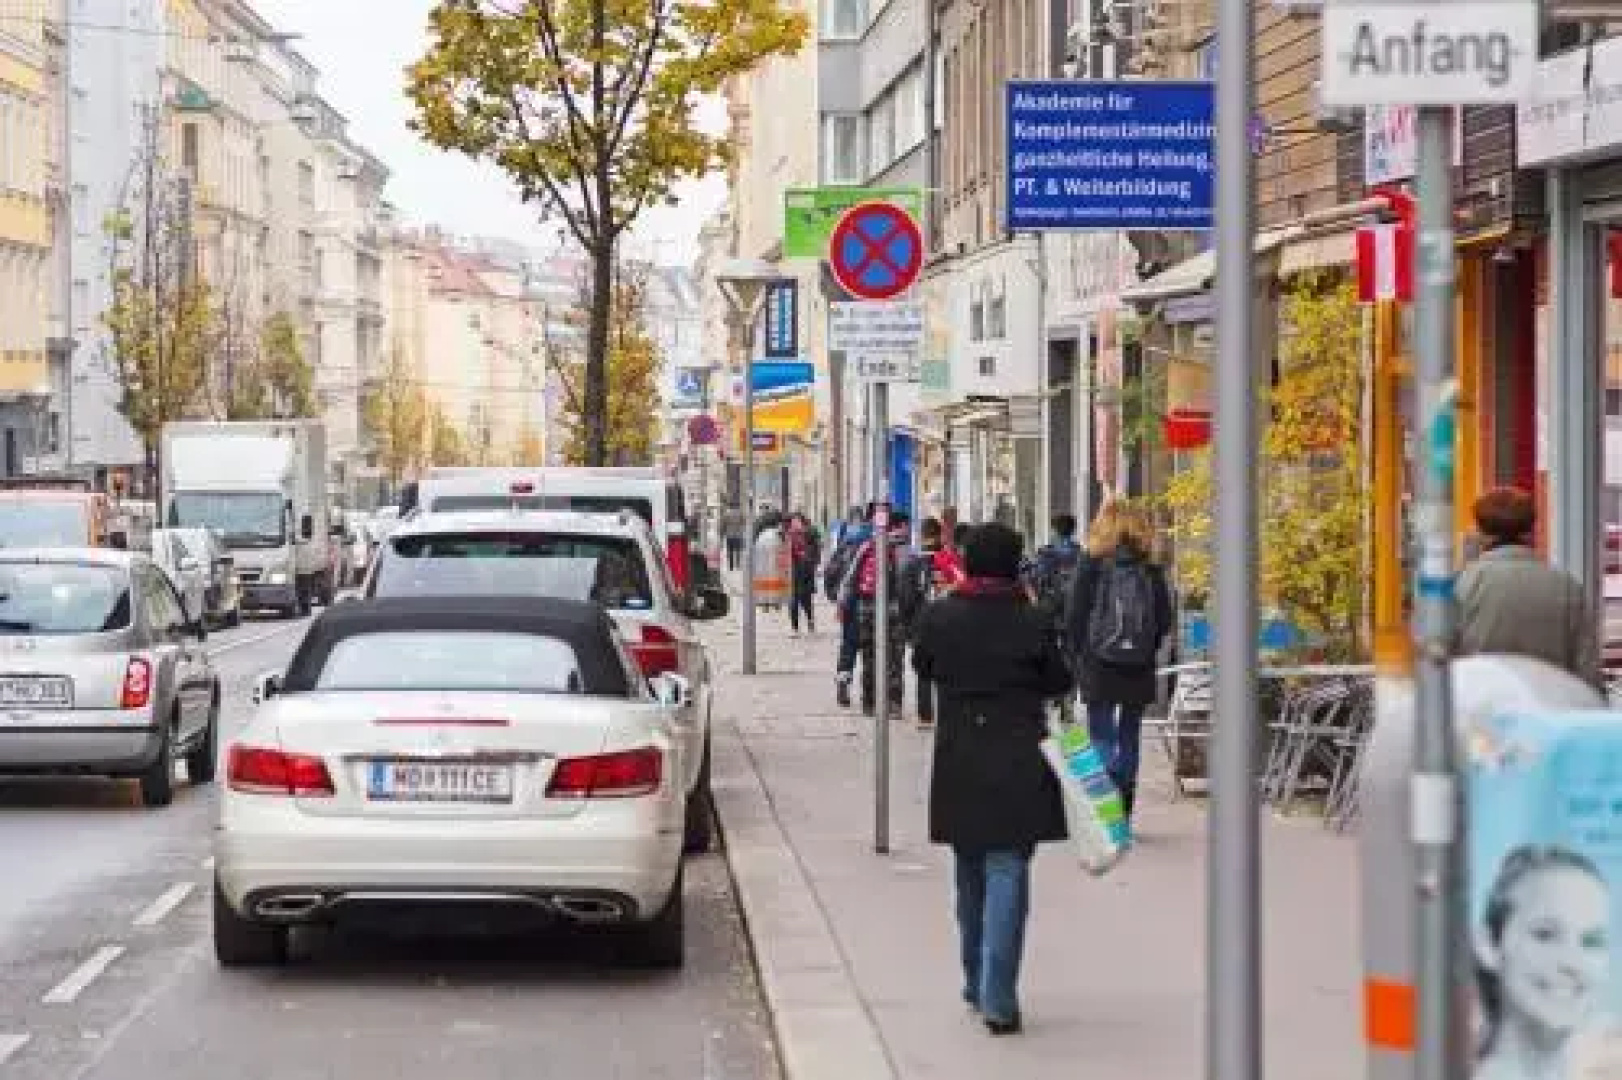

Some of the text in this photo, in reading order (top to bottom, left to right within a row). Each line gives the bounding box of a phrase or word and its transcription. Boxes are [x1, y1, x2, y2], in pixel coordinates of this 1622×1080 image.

[1351, 20, 1511, 86] Anfang
[1013, 93, 1135, 111] Akademie für
[1014, 176, 1192, 199] PT. & Weiterbildung
